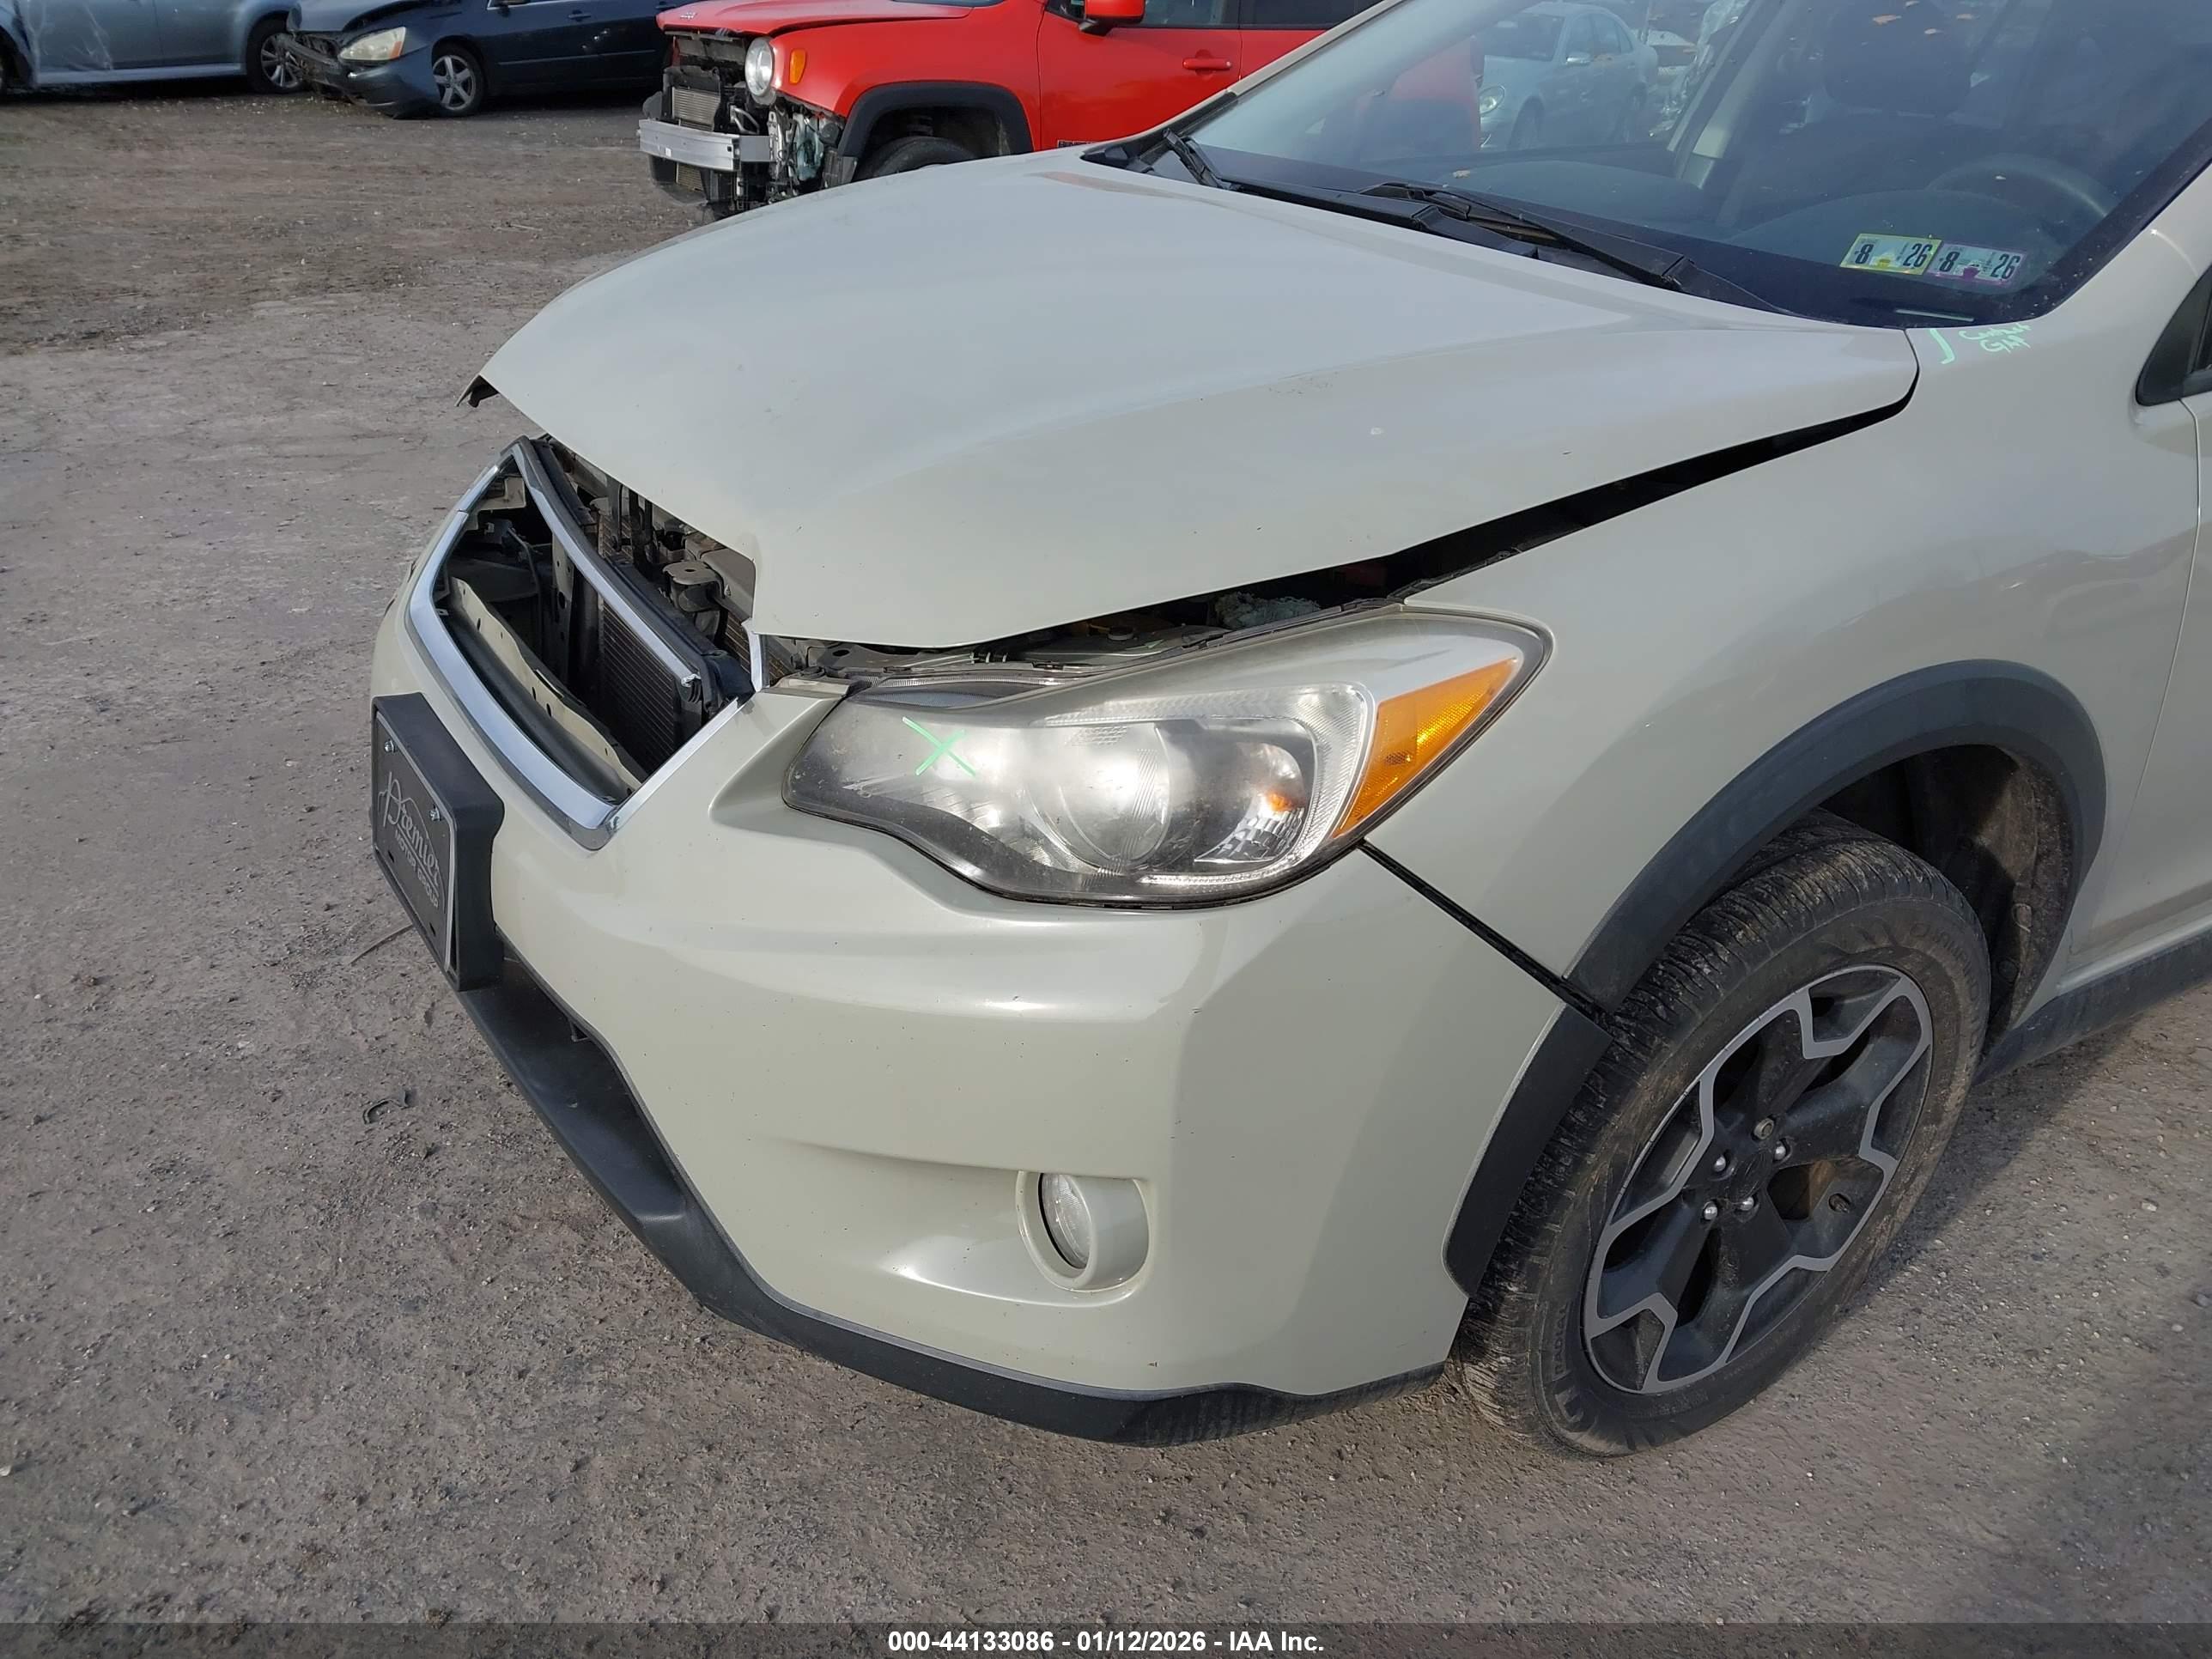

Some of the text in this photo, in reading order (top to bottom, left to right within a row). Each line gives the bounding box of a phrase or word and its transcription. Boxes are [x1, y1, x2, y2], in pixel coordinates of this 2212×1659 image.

[1855, 244, 1874, 264] 8
[1903, 243, 1933, 268] 26
[1939, 252, 1960, 272] 8
[1990, 253, 2021, 279] 26
[383, 771, 440, 888] Premier
[395, 829, 439, 908] MOTOR GROUP
